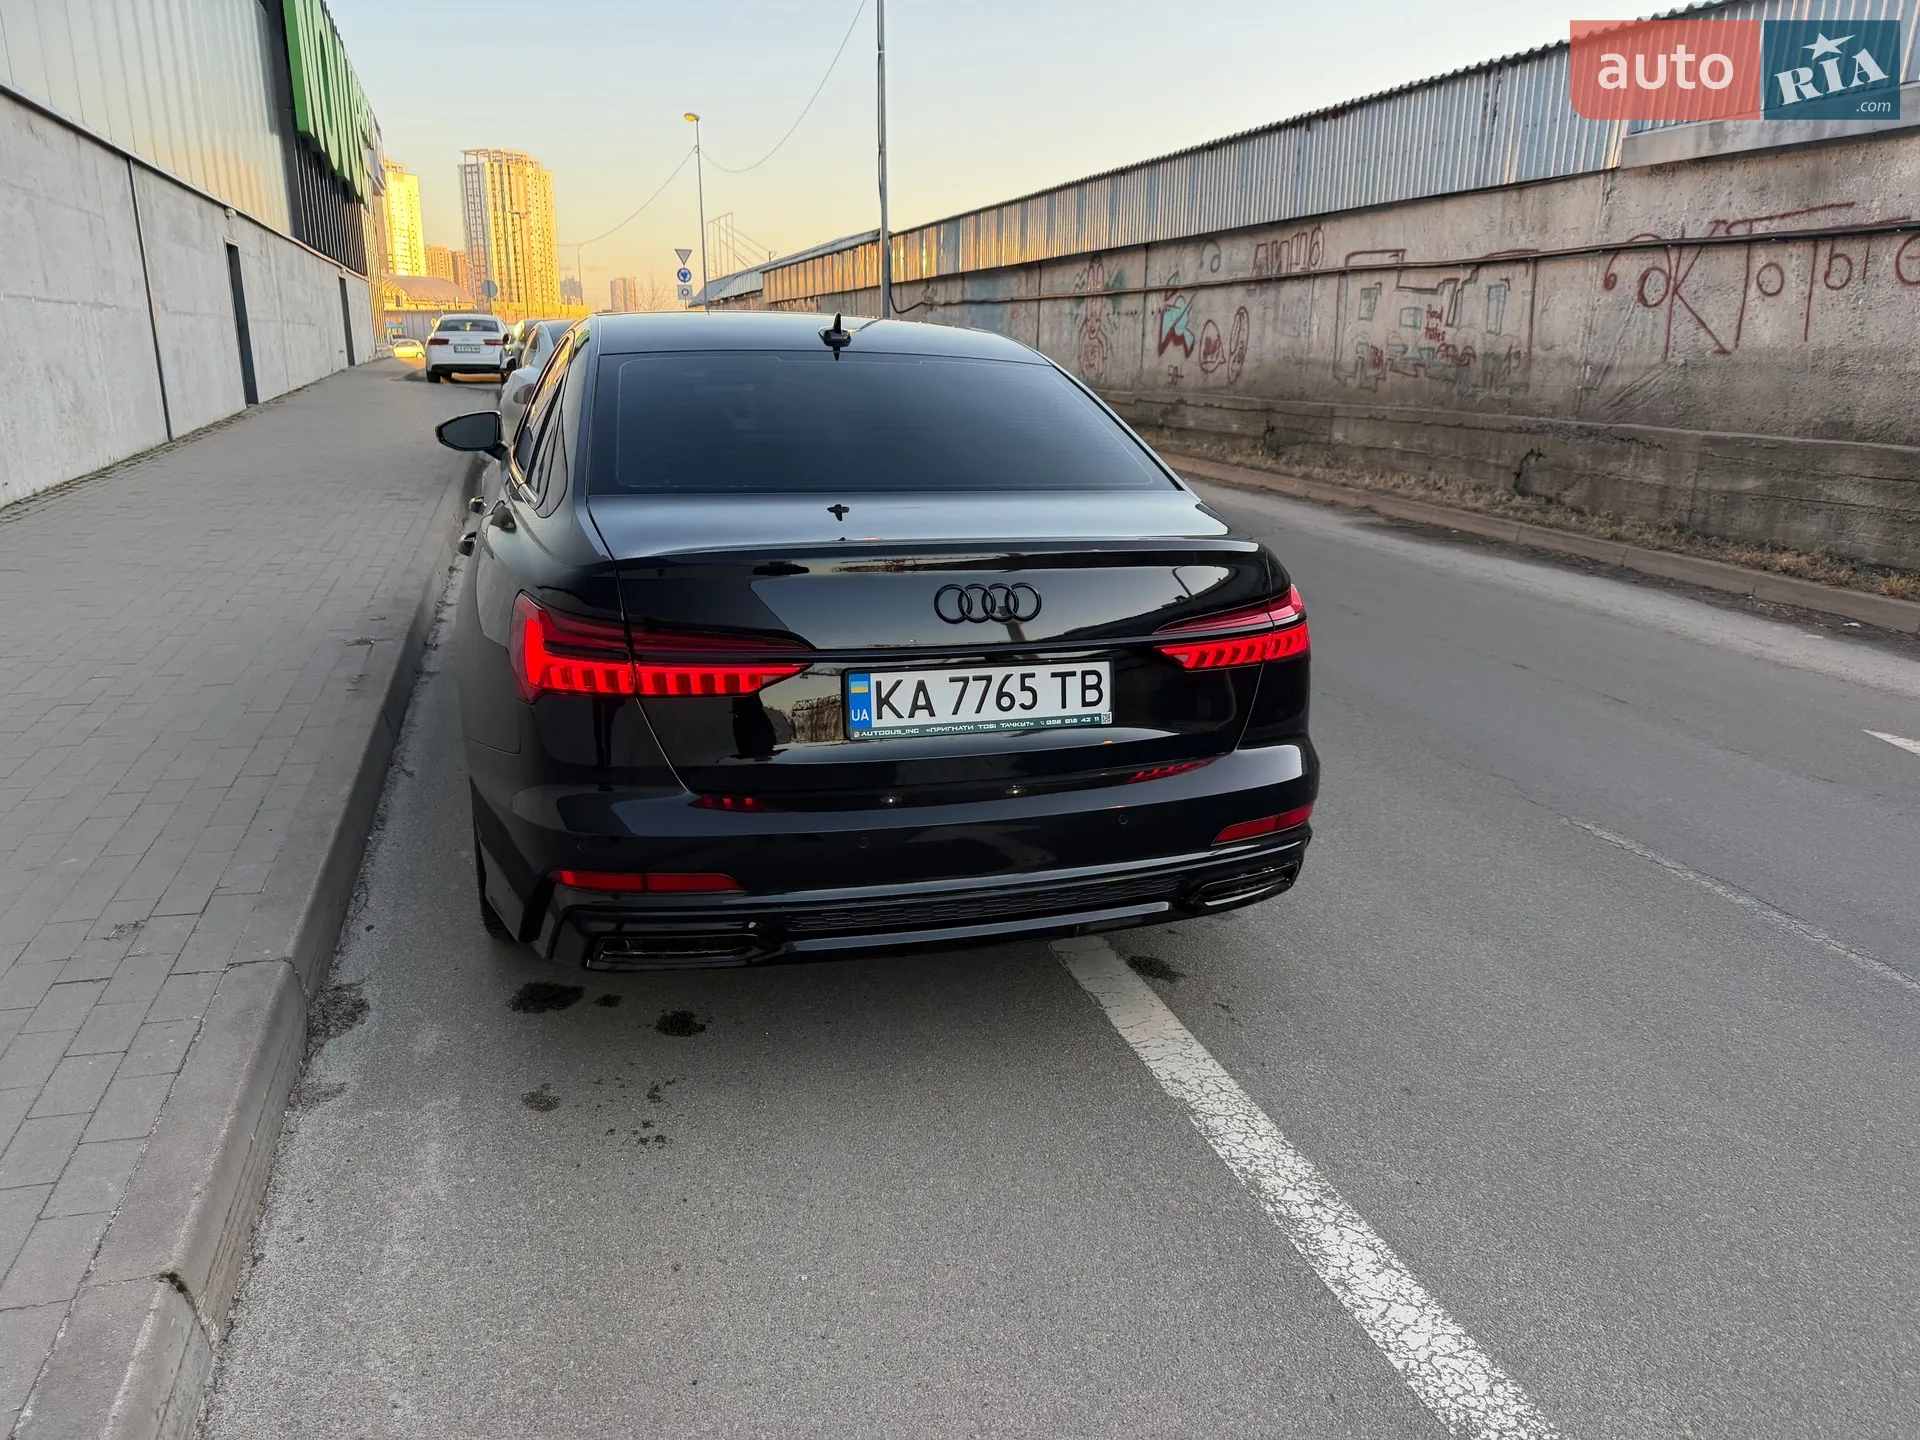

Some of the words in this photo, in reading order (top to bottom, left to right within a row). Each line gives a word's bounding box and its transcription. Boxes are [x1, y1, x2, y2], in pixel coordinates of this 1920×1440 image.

[875, 679, 936, 720] KA
[948, 672, 1038, 716] 7765
[1050, 669, 1104, 710] TB
[851, 709, 870, 722] UA
